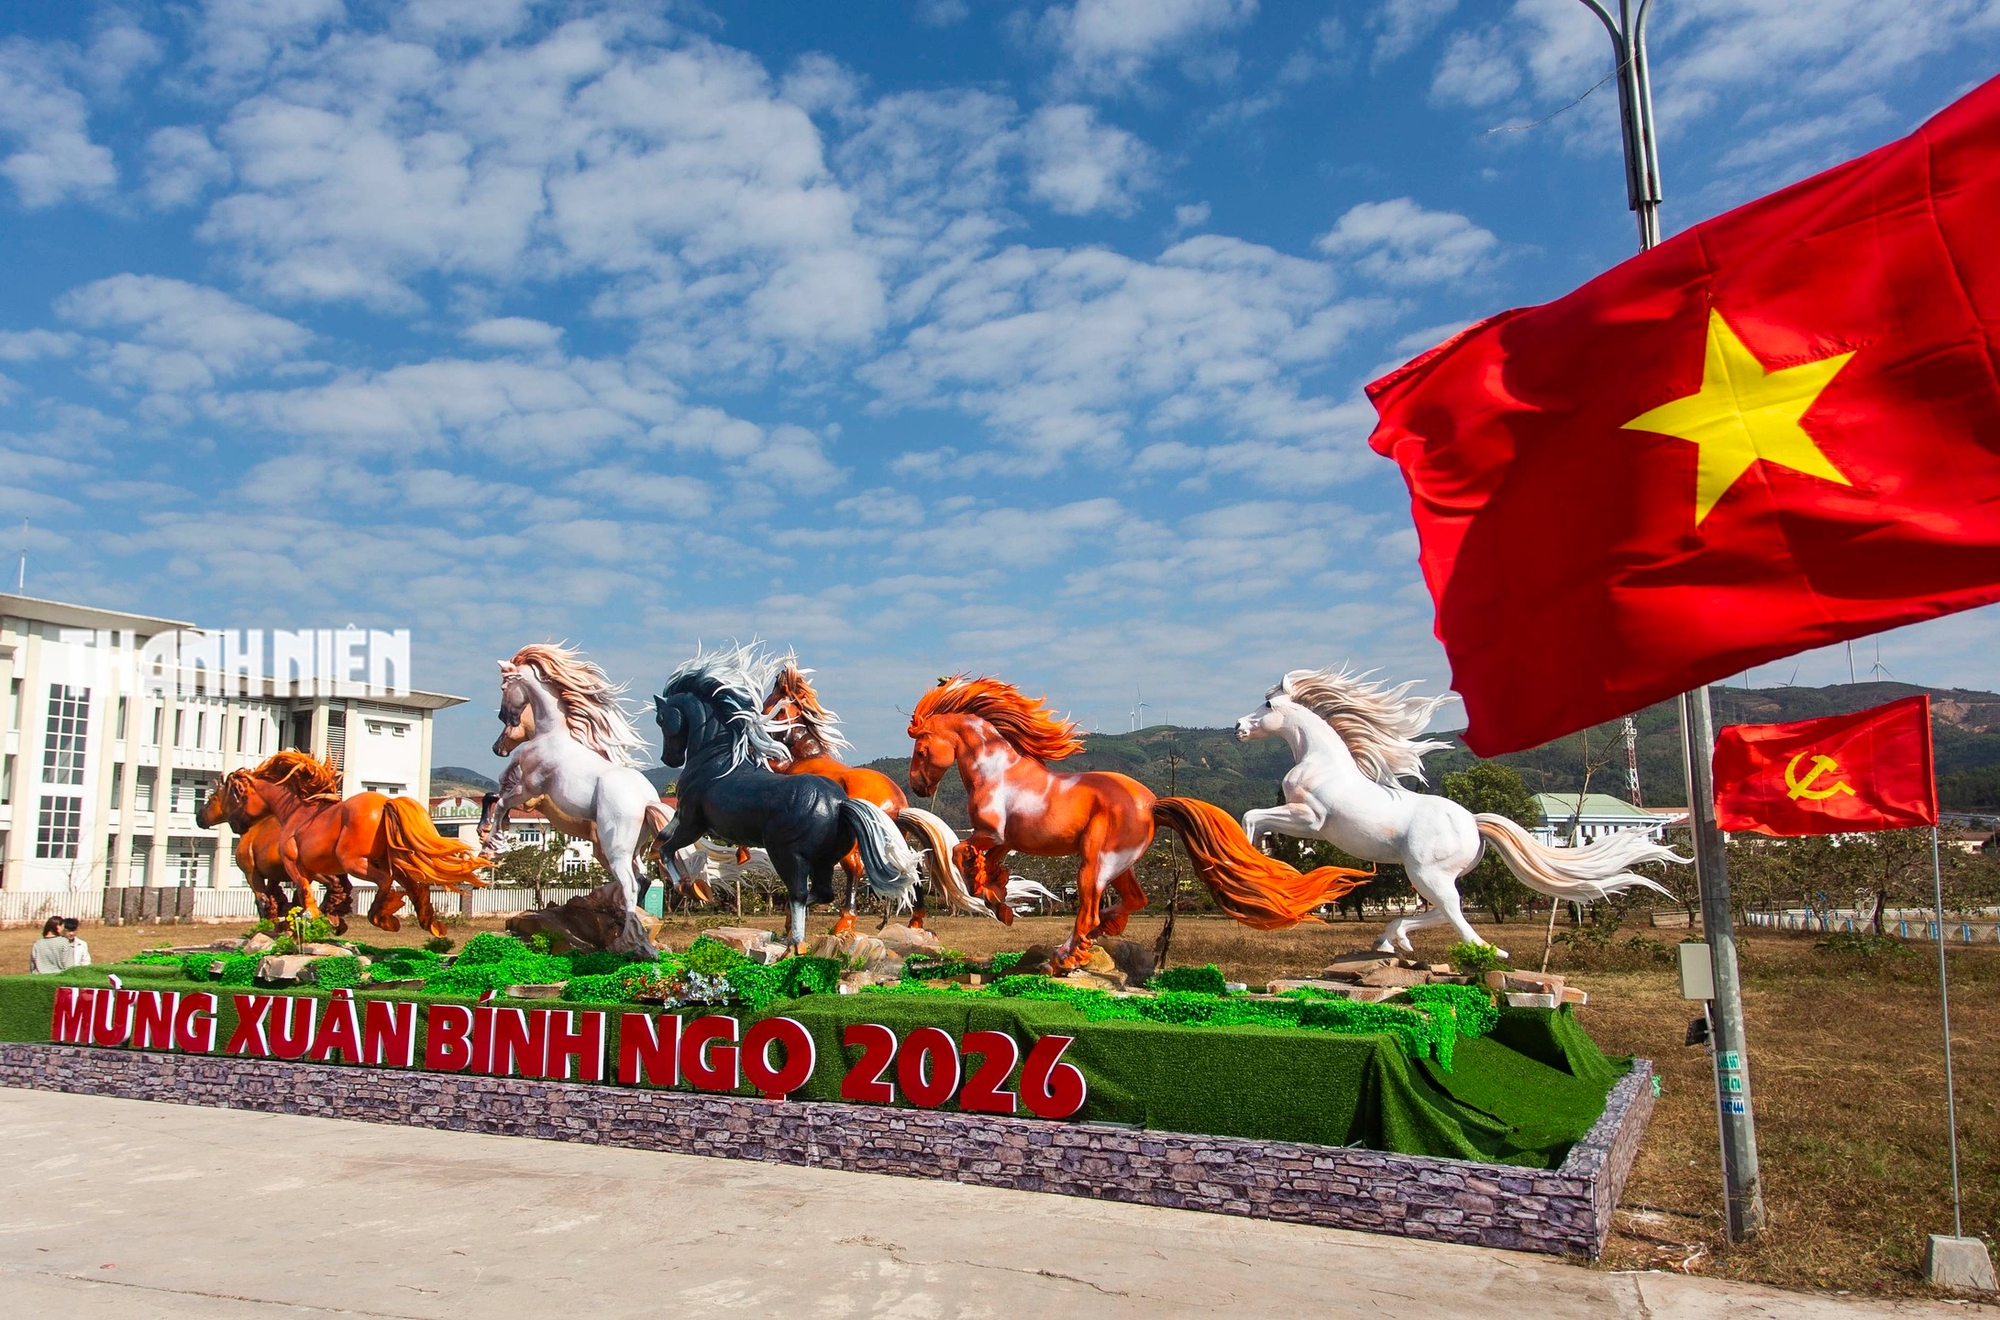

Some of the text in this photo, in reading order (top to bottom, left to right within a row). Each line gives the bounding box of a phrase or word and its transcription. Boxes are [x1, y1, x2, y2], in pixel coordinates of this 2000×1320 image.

[451, 806, 482, 818] Hote
[50, 973, 219, 1052] MỪNG
[225, 988, 418, 1067] XUÂN
[425, 989, 606, 1081] BÍNH
[840, 1023, 1087, 1119] 2026
